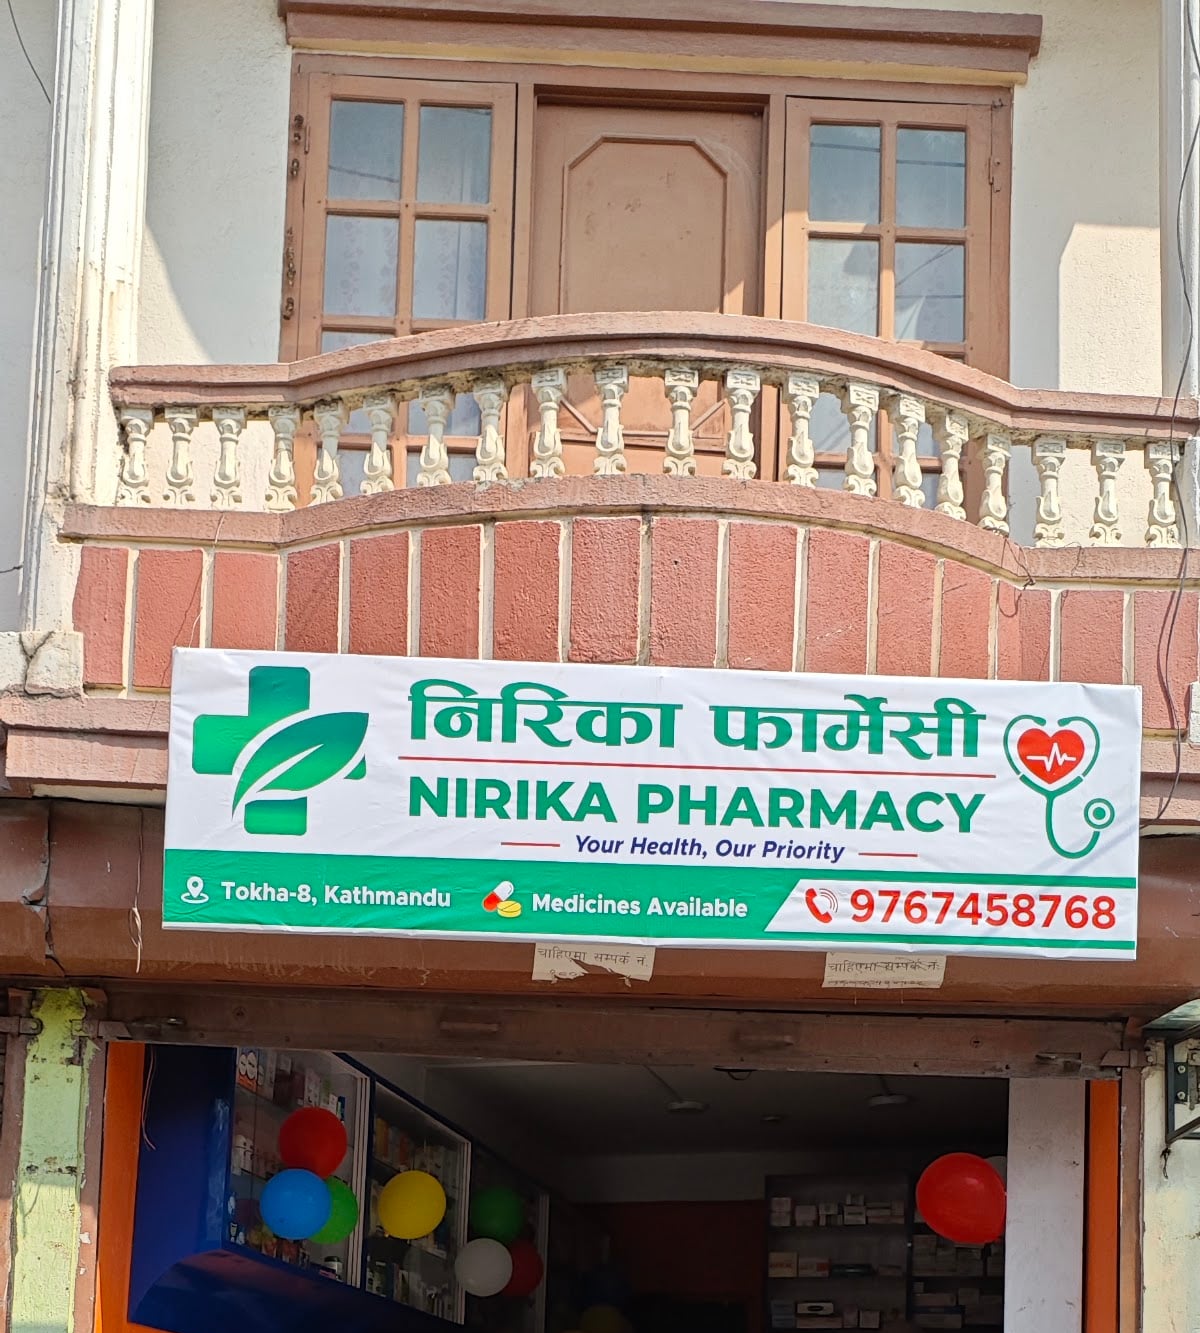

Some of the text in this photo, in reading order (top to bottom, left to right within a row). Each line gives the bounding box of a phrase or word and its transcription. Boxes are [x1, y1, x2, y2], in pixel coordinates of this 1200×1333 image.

[408, 678, 986, 760] निरिका फार्मेसी
[409, 776, 985, 833] NIRIKA PHARMACY
[576, 835, 845, 863] Your Health, Our Priority
[221, 881, 451, 908] Tokha-8, Kathmandu
[532, 893, 748, 918] Medicines Available
[850, 888, 1116, 930] 9767458768
